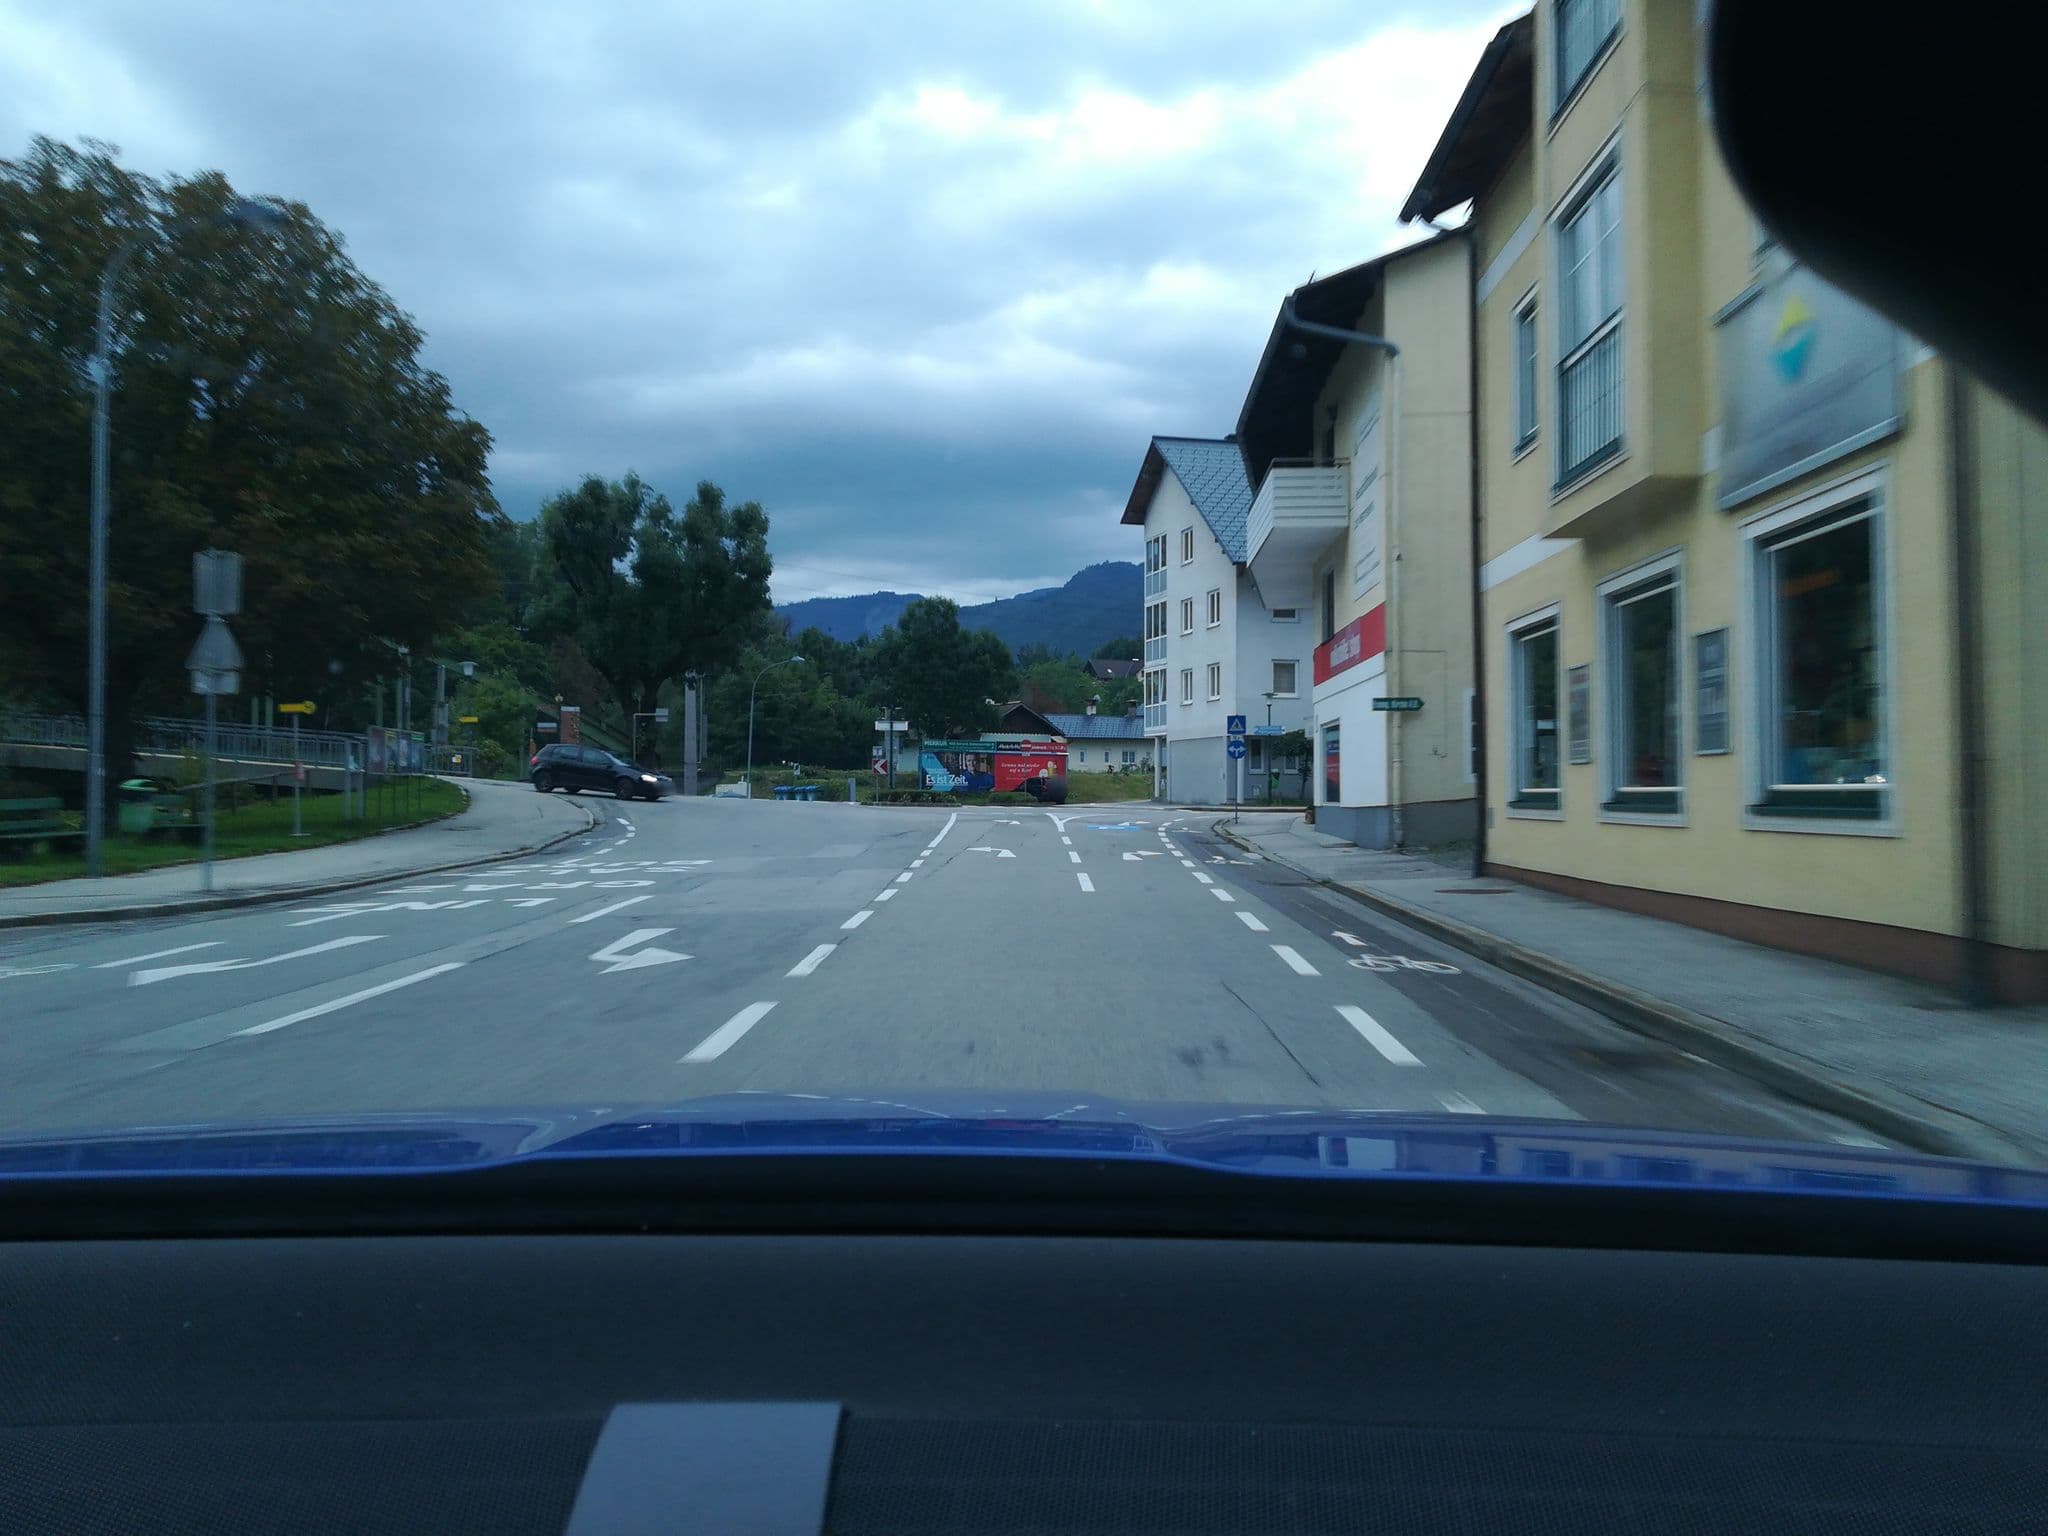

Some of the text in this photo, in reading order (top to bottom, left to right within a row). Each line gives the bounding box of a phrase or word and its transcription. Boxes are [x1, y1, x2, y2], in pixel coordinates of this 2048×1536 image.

[926, 774, 968, 784] Es ist Zeit.
[376, 880, 656, 894] GRAZ
[288, 898, 558, 914] LINZ
